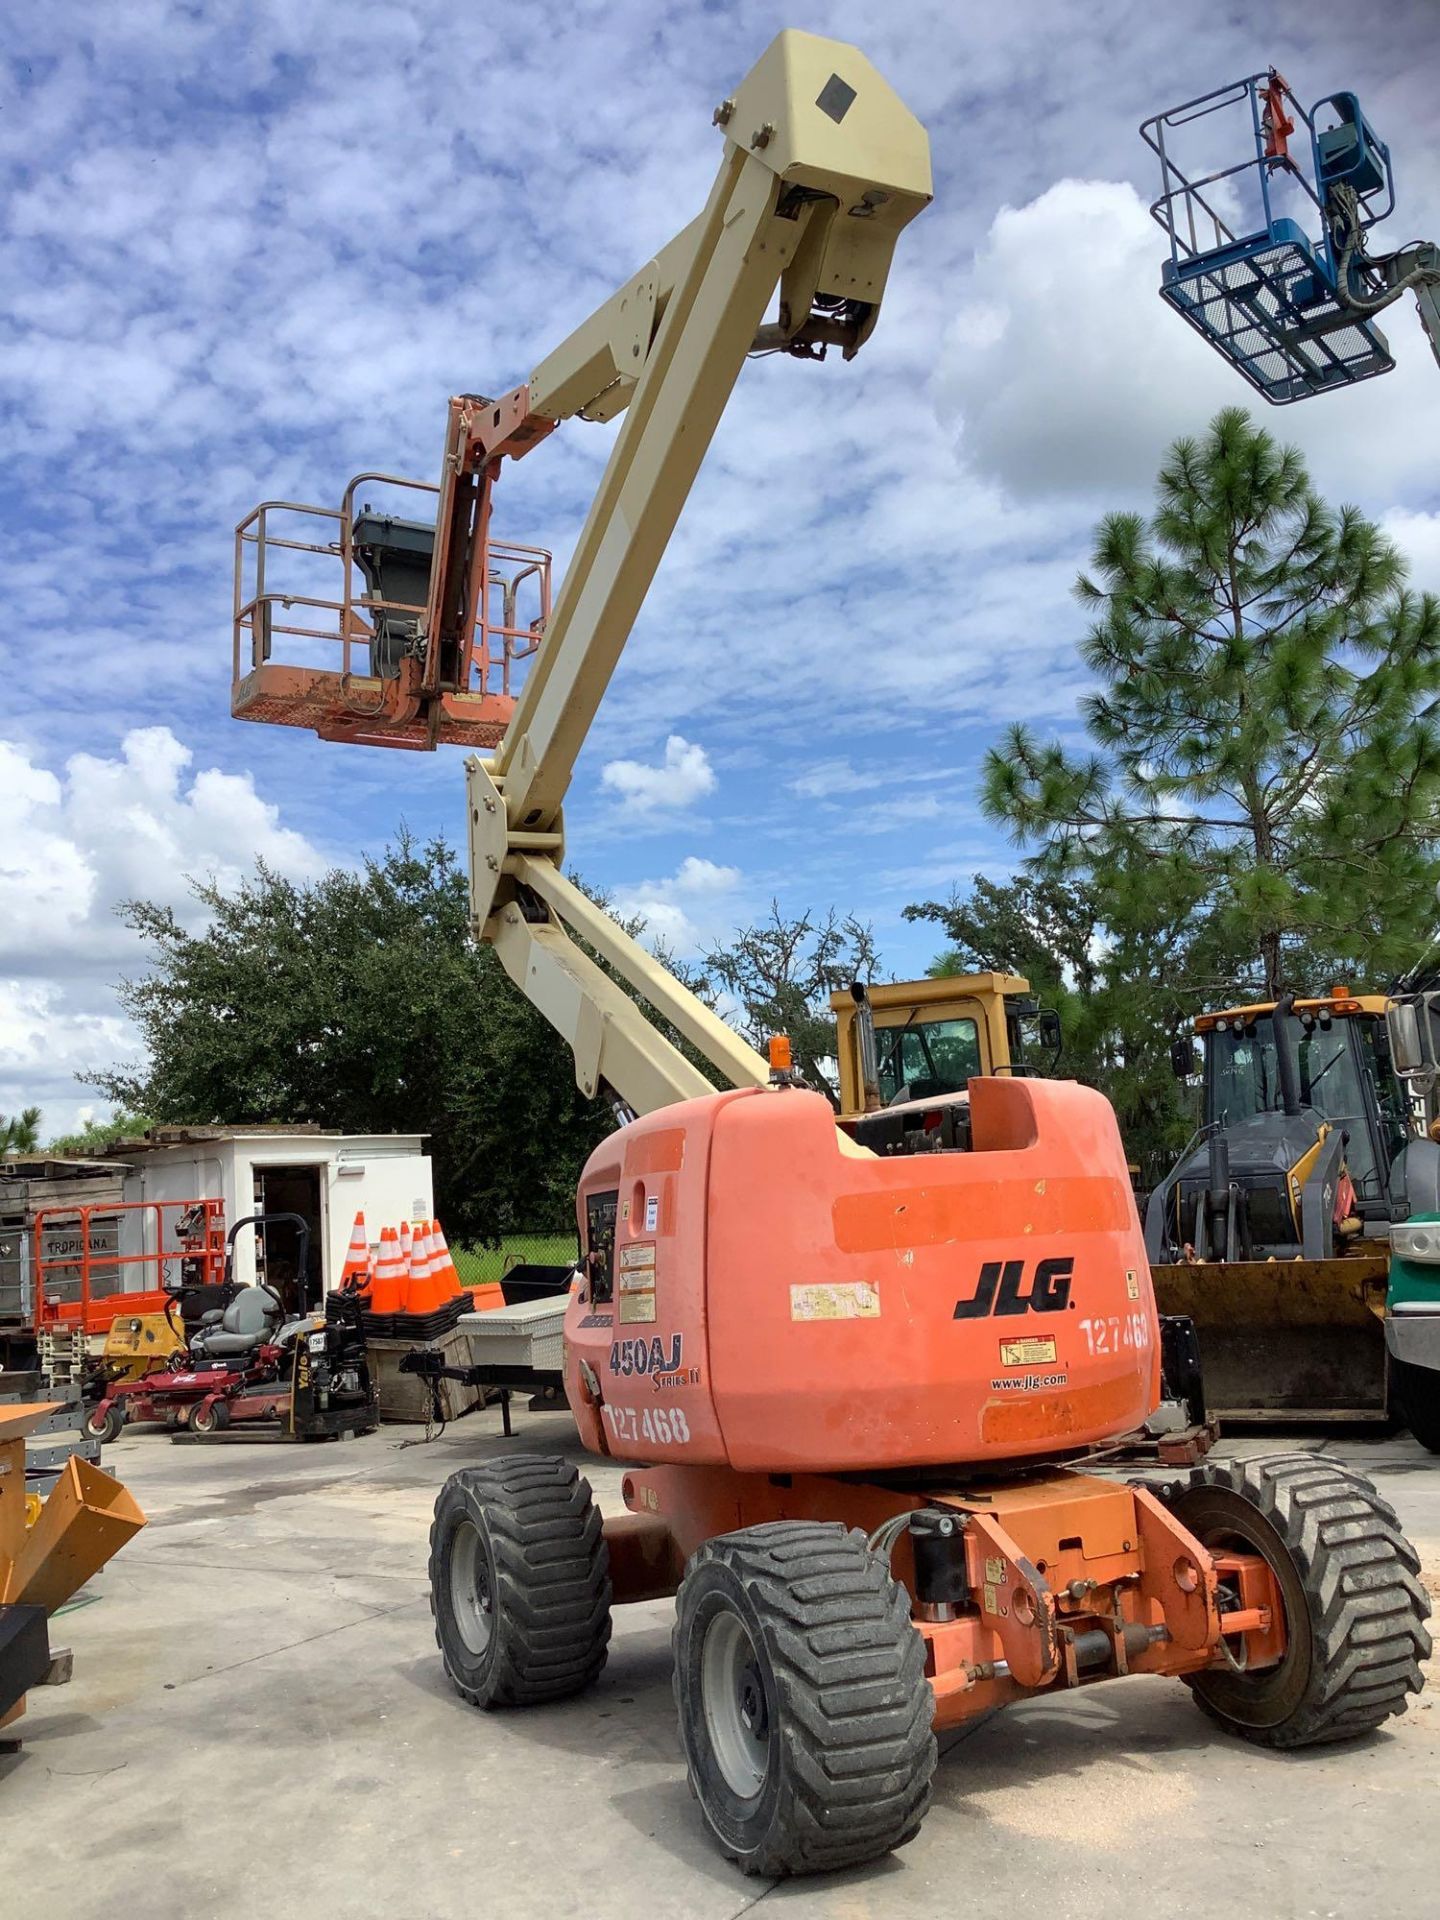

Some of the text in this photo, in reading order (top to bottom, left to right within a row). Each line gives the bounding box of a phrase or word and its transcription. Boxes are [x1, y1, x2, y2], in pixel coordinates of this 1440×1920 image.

[953, 1257, 1075, 1319] JLG
[298, 1355, 309, 1389] Yale
[609, 1332, 683, 1377] 450AJ
[992, 1375, 1067, 1391] www.jlg.com
[600, 1403, 690, 1444] 127468
